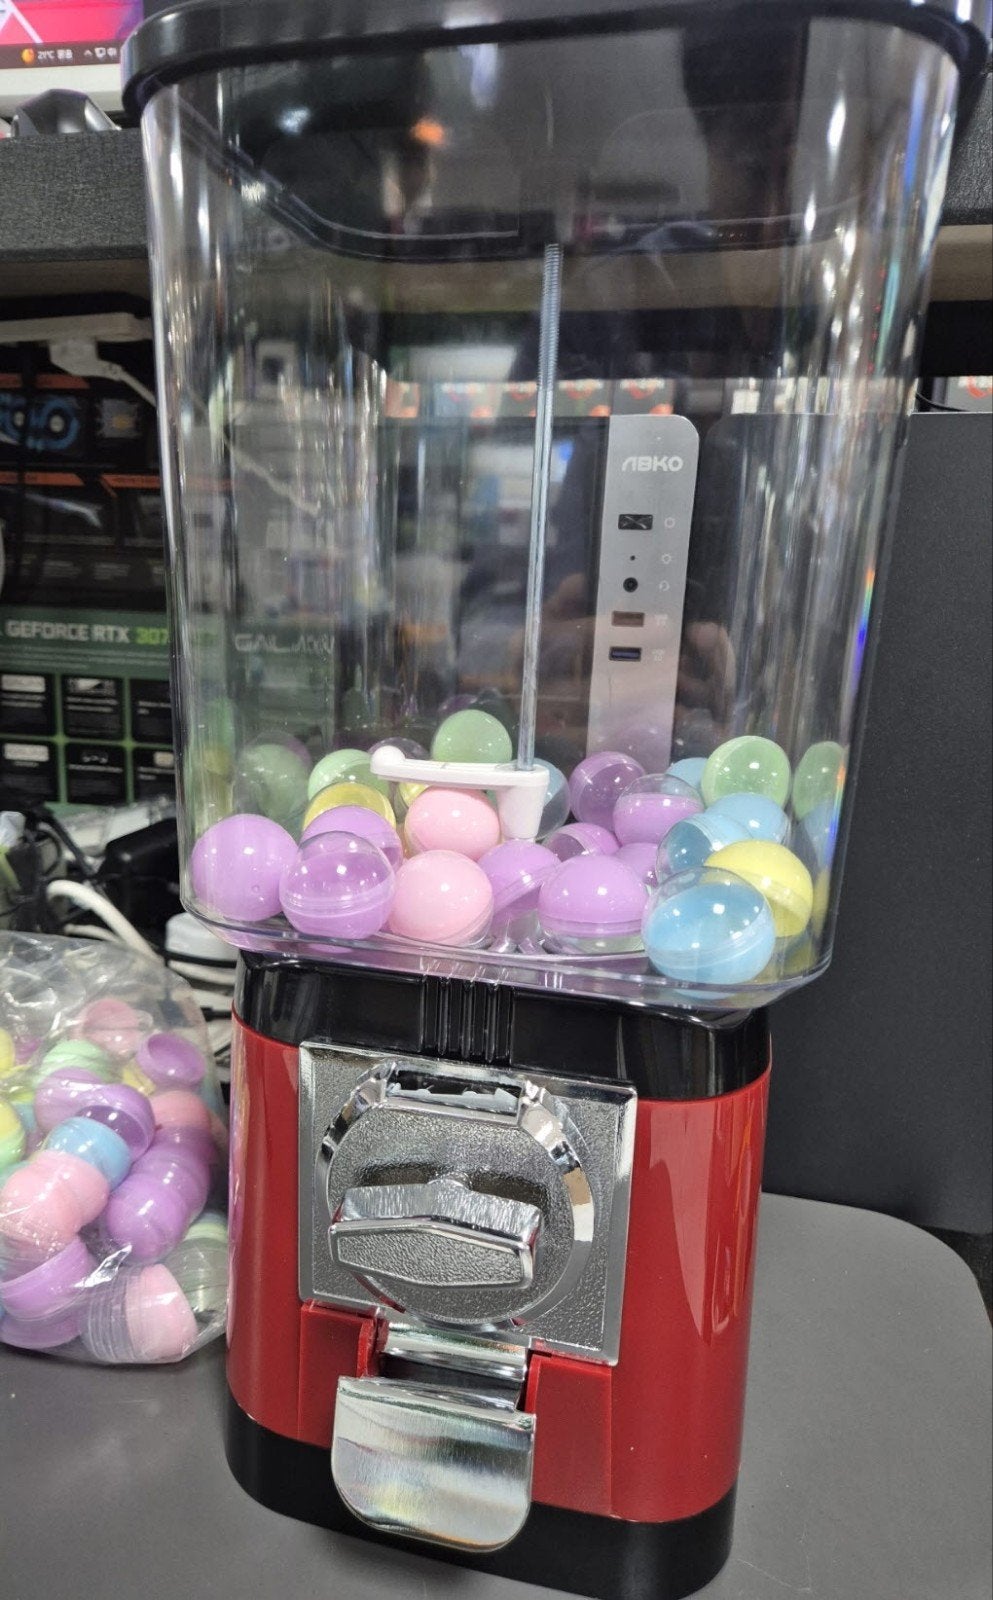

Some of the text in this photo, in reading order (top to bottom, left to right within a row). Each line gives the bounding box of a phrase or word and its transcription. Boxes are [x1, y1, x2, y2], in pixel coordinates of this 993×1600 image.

[621, 456, 684, 472] ABKO
[6, 620, 169, 645] GEFORCE RTX 307
